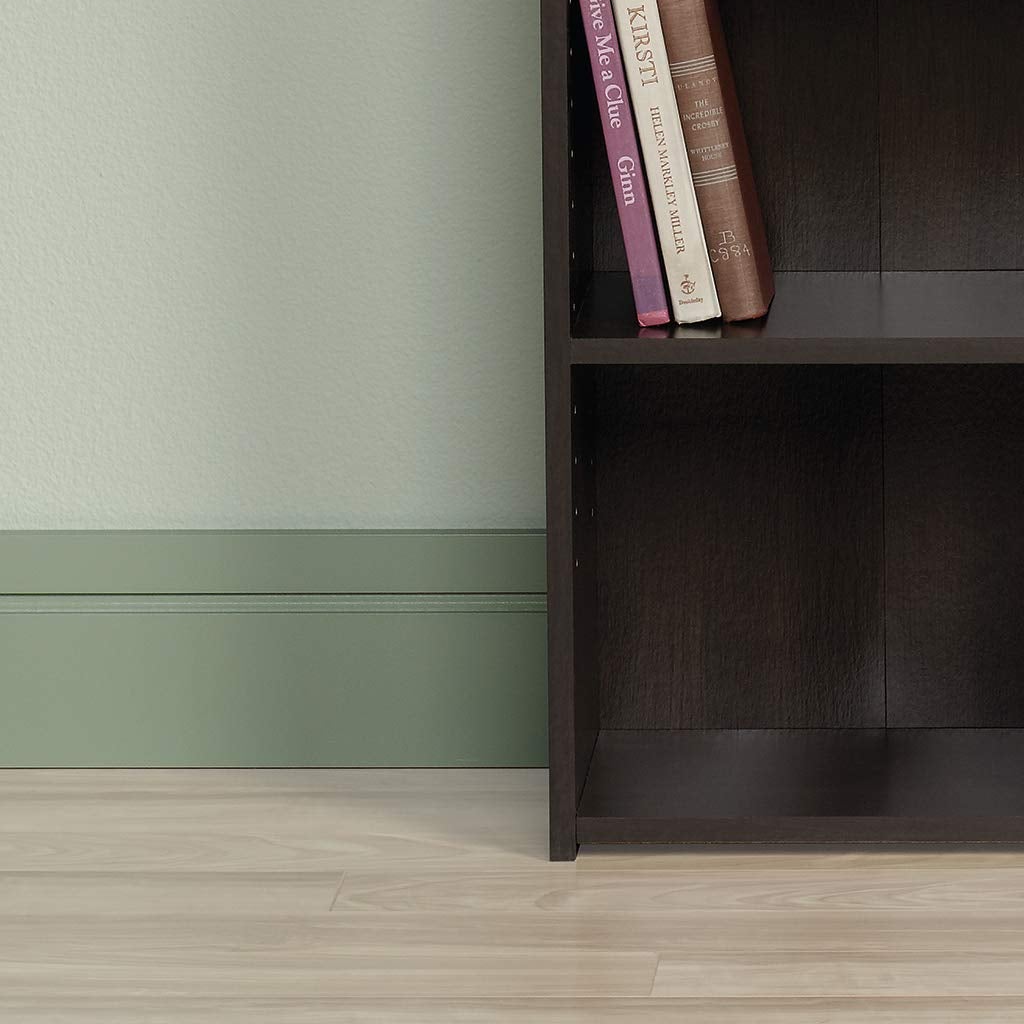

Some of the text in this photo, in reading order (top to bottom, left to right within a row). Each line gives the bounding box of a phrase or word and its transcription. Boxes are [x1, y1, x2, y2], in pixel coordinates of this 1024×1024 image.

[595, 33, 615, 66] Me
[627, 5, 659, 87] KIRSTI
[601, 70, 613, 81] a
[604, 84, 624, 129] Clue
[694, 98, 709, 108] THE
[617, 156, 636, 206] Ginn
[650, 106, 686, 255] HELEN MARKLEY MILLER
[718, 230, 736, 245] B
